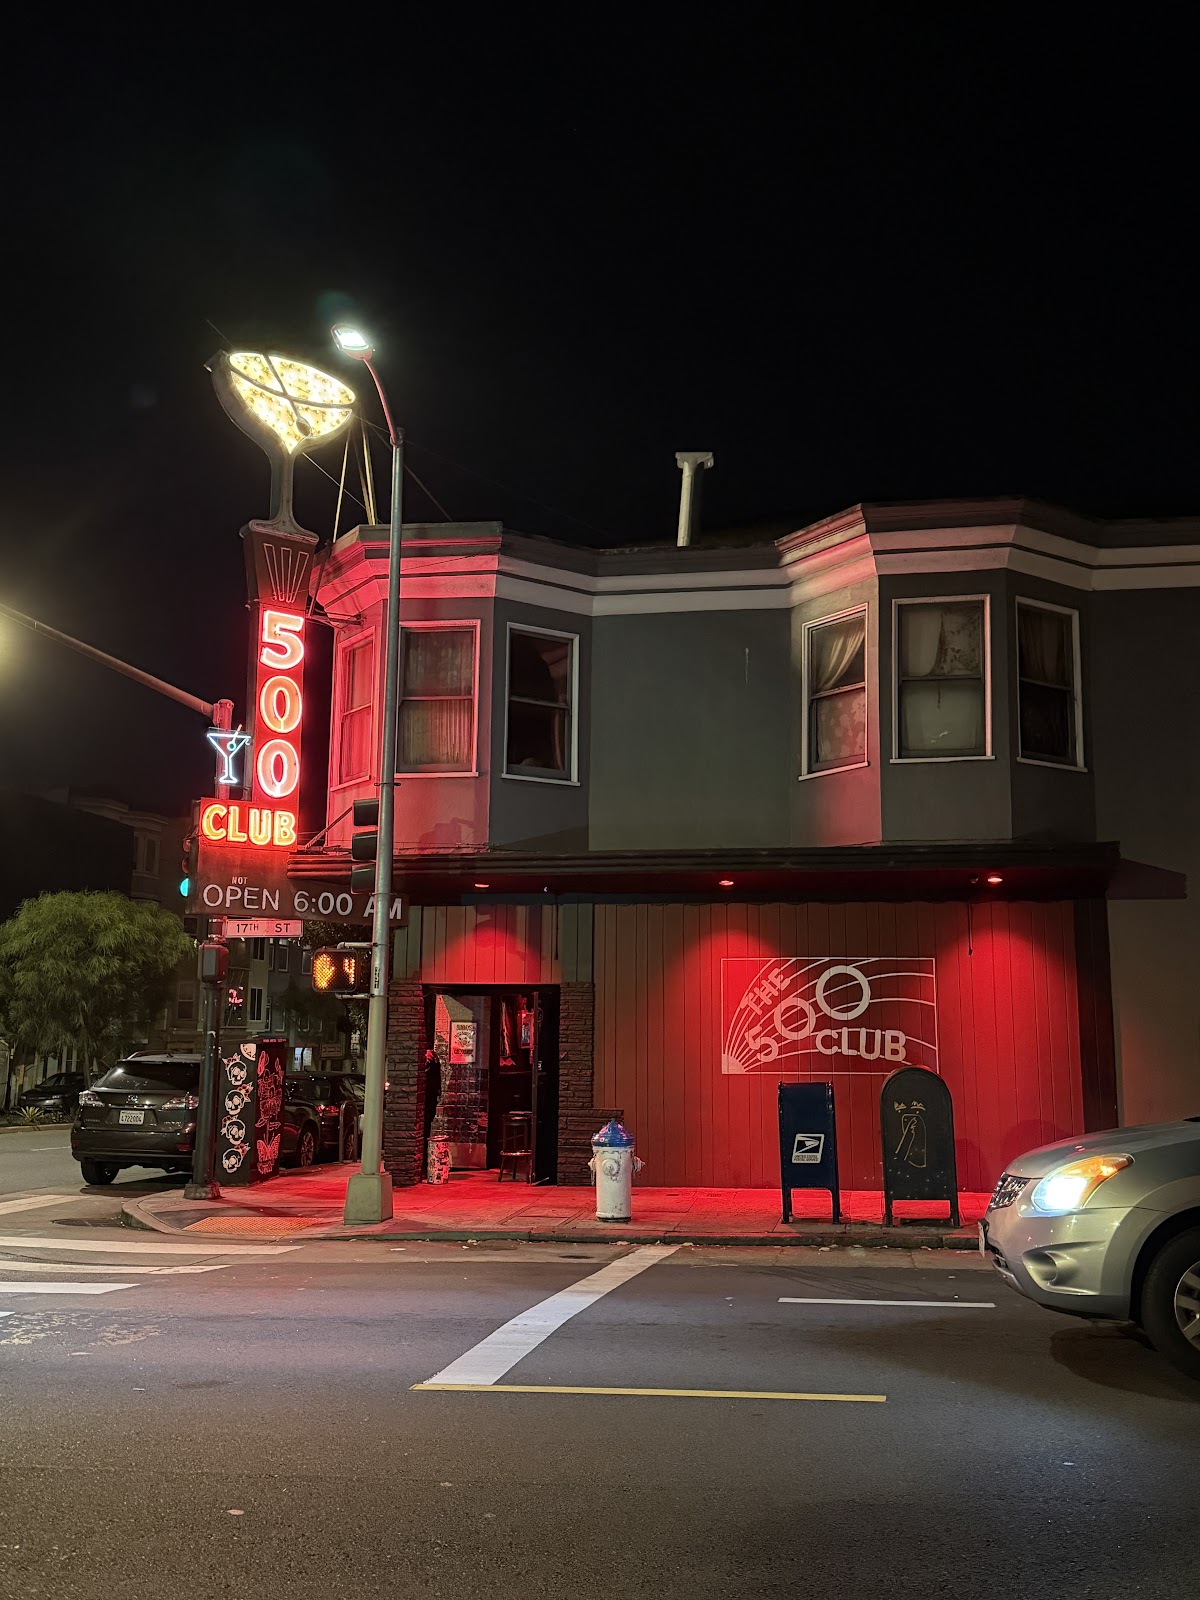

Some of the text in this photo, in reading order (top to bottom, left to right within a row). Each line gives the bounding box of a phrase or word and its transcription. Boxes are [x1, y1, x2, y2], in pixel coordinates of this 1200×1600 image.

[256, 610, 305, 798] 500
[201, 804, 297, 846] CLUB
[203, 884, 280, 911] OPEN
[294, 890, 353, 916] 6:00
[232, 876, 248, 885] NOT
[236, 923, 291, 933] 17TH ST
[740, 967, 791, 1016] THE
[745, 965, 871, 1063] 500
[815, 1026, 907, 1062] CLUB
